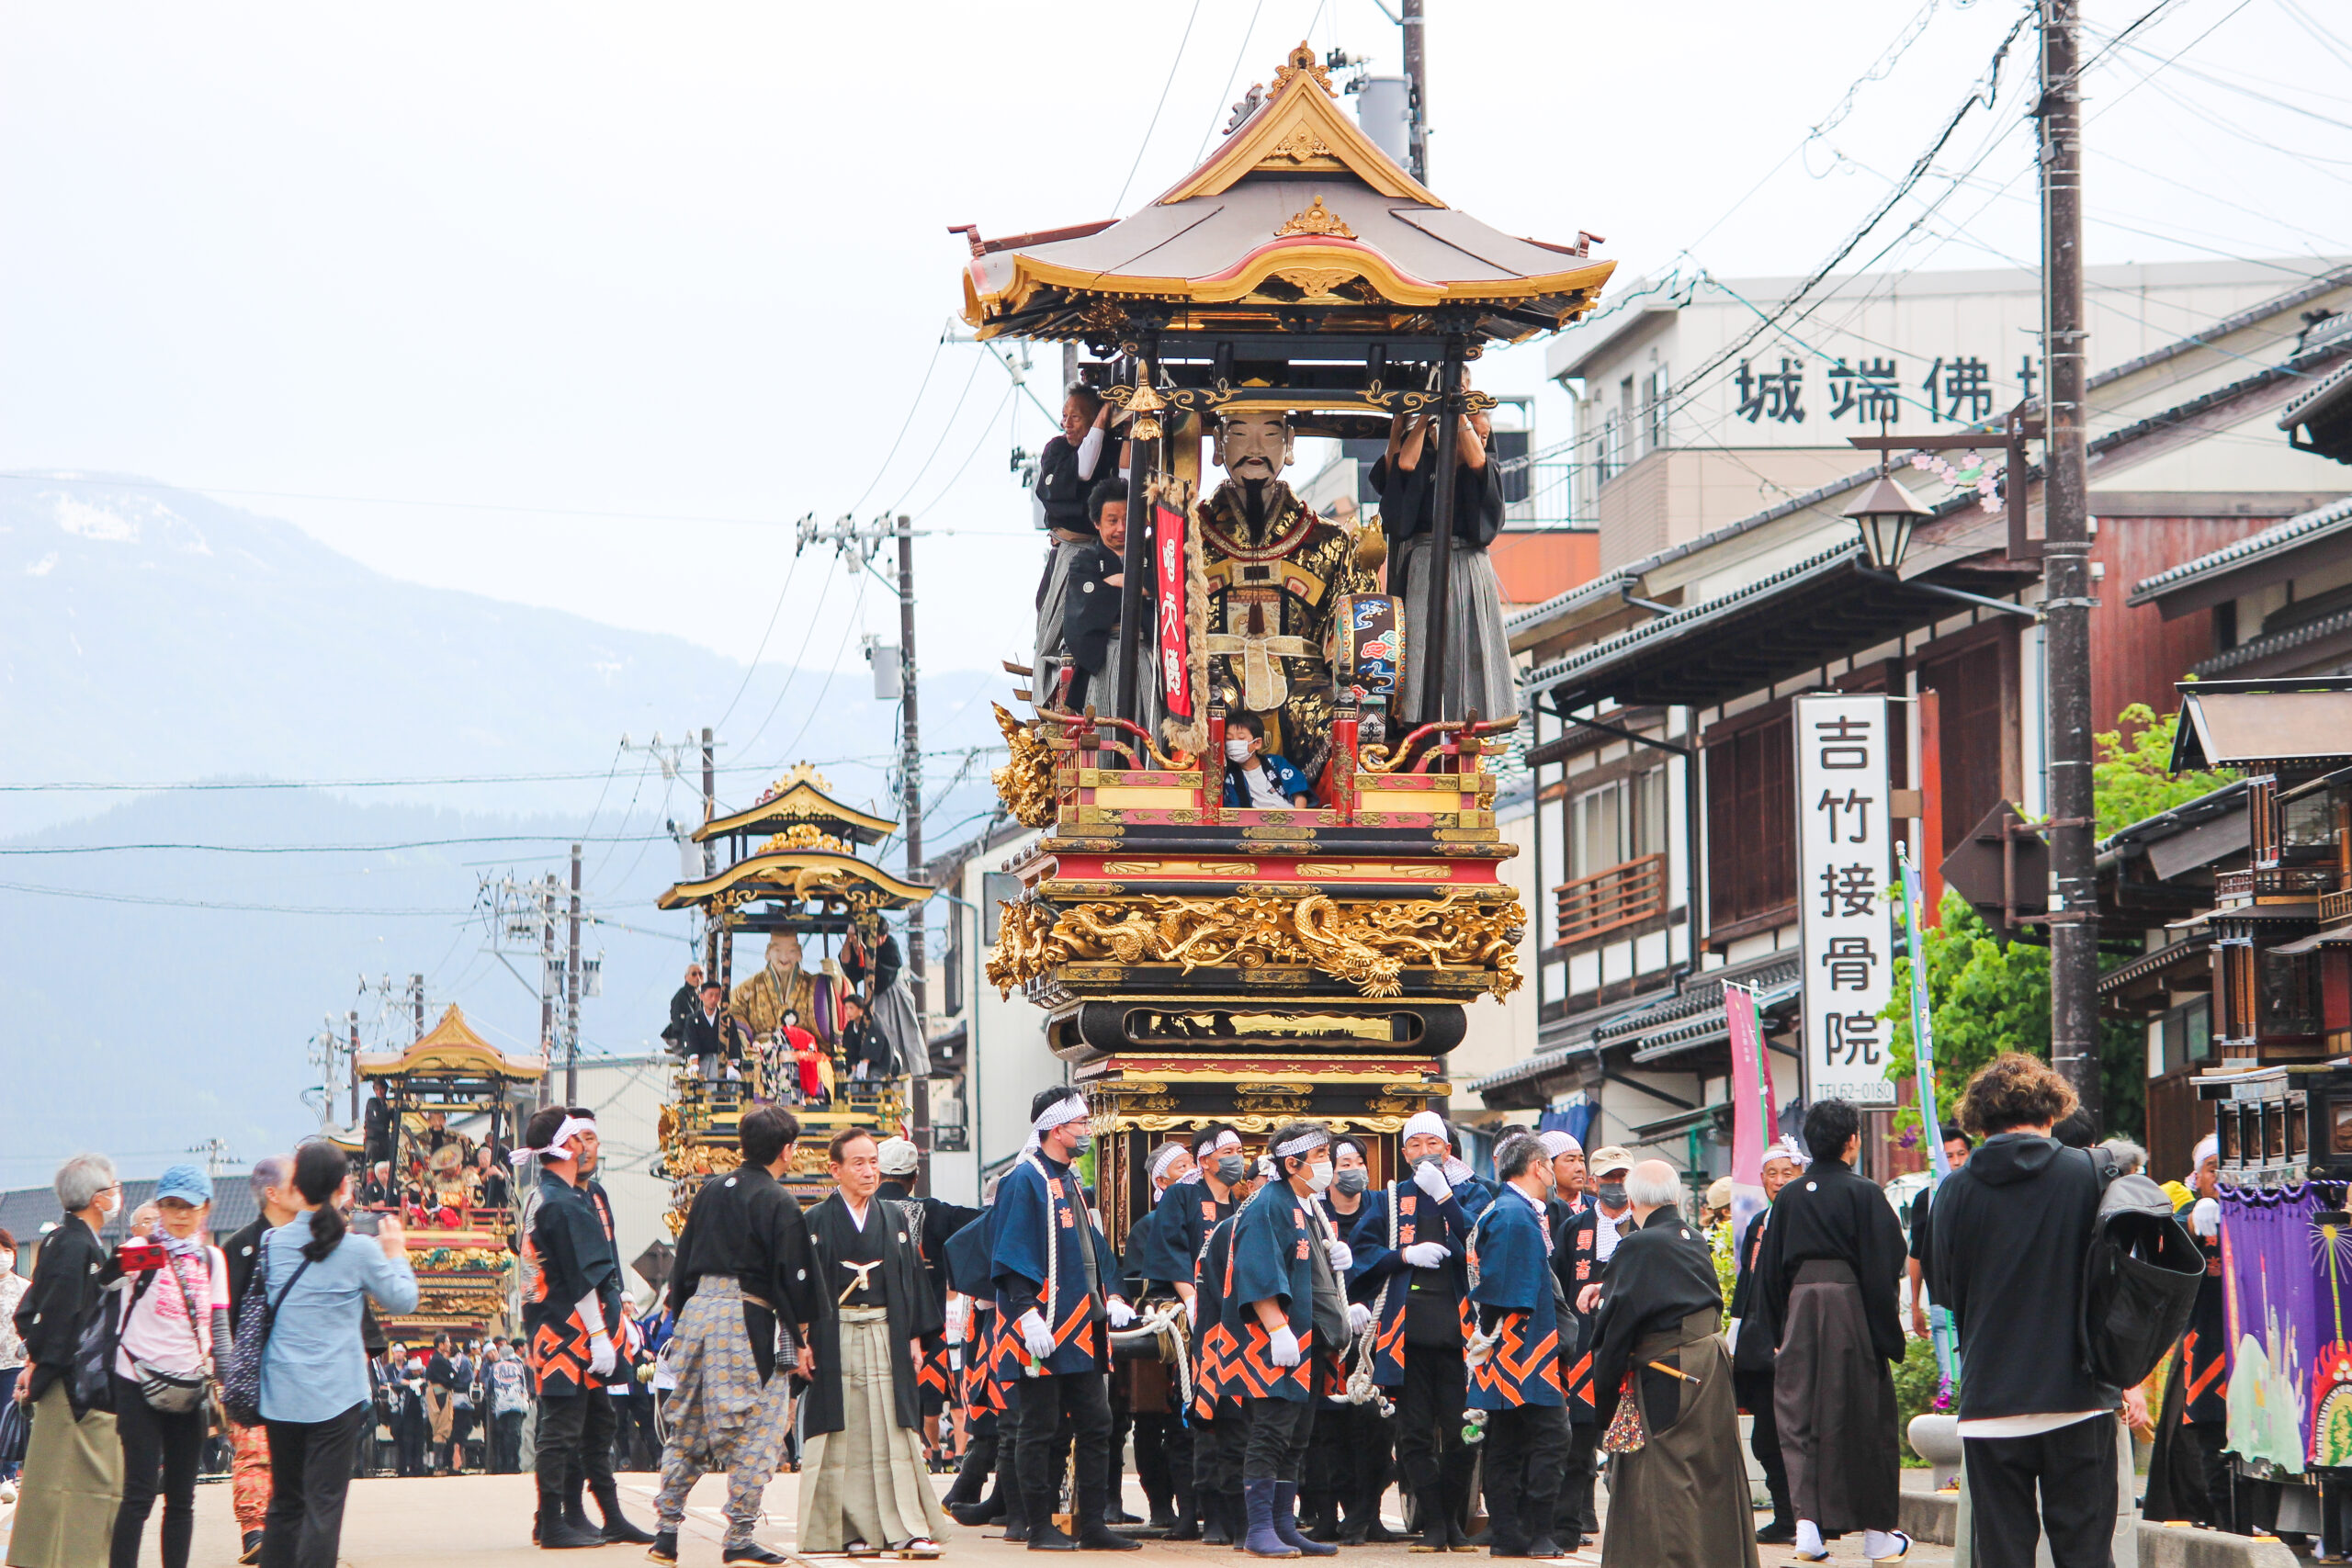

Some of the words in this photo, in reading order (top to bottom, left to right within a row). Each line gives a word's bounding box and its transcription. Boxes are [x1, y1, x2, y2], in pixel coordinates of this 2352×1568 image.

[1815, 716, 1880, 1066] 吉竹接骨院
